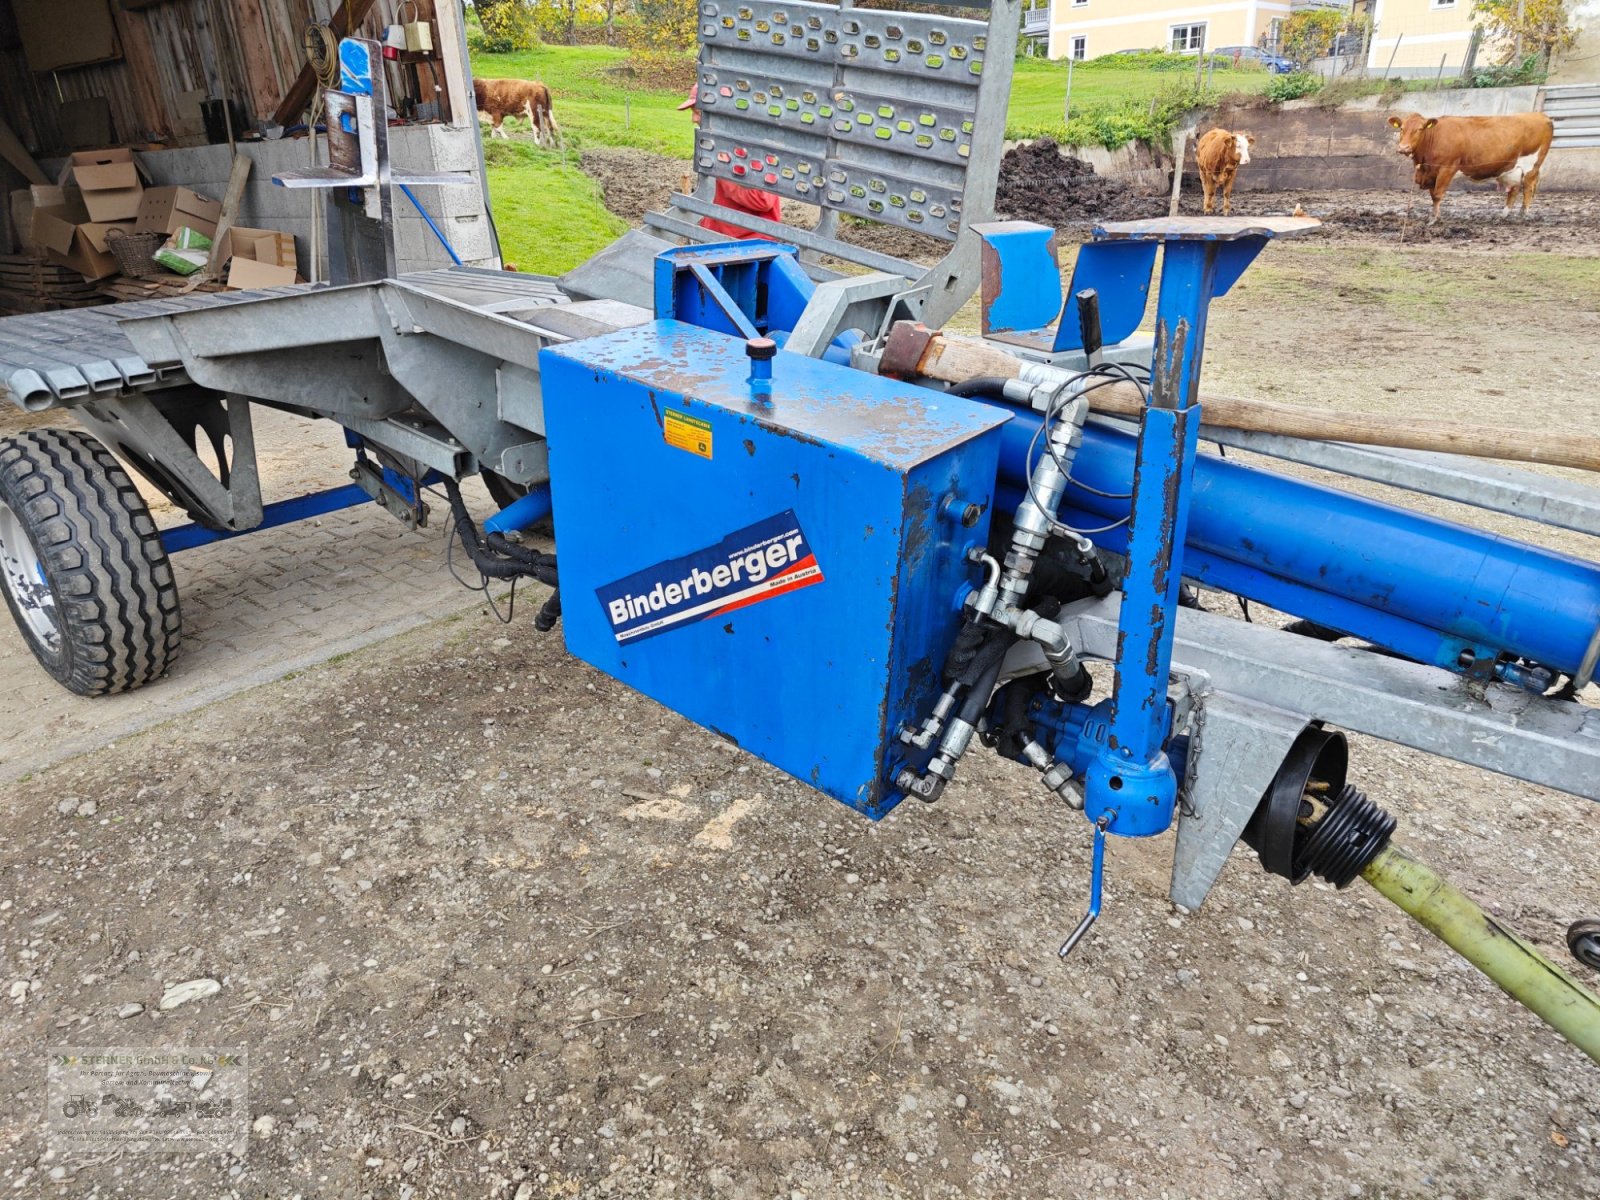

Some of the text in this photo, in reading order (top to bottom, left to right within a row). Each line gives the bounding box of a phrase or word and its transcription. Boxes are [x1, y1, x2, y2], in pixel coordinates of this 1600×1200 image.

[728, 528, 799, 559] www.binderberger.com
[608, 534, 803, 625] Binderberger
[769, 578, 786, 588] Made
[794, 568, 816, 579] Austria
